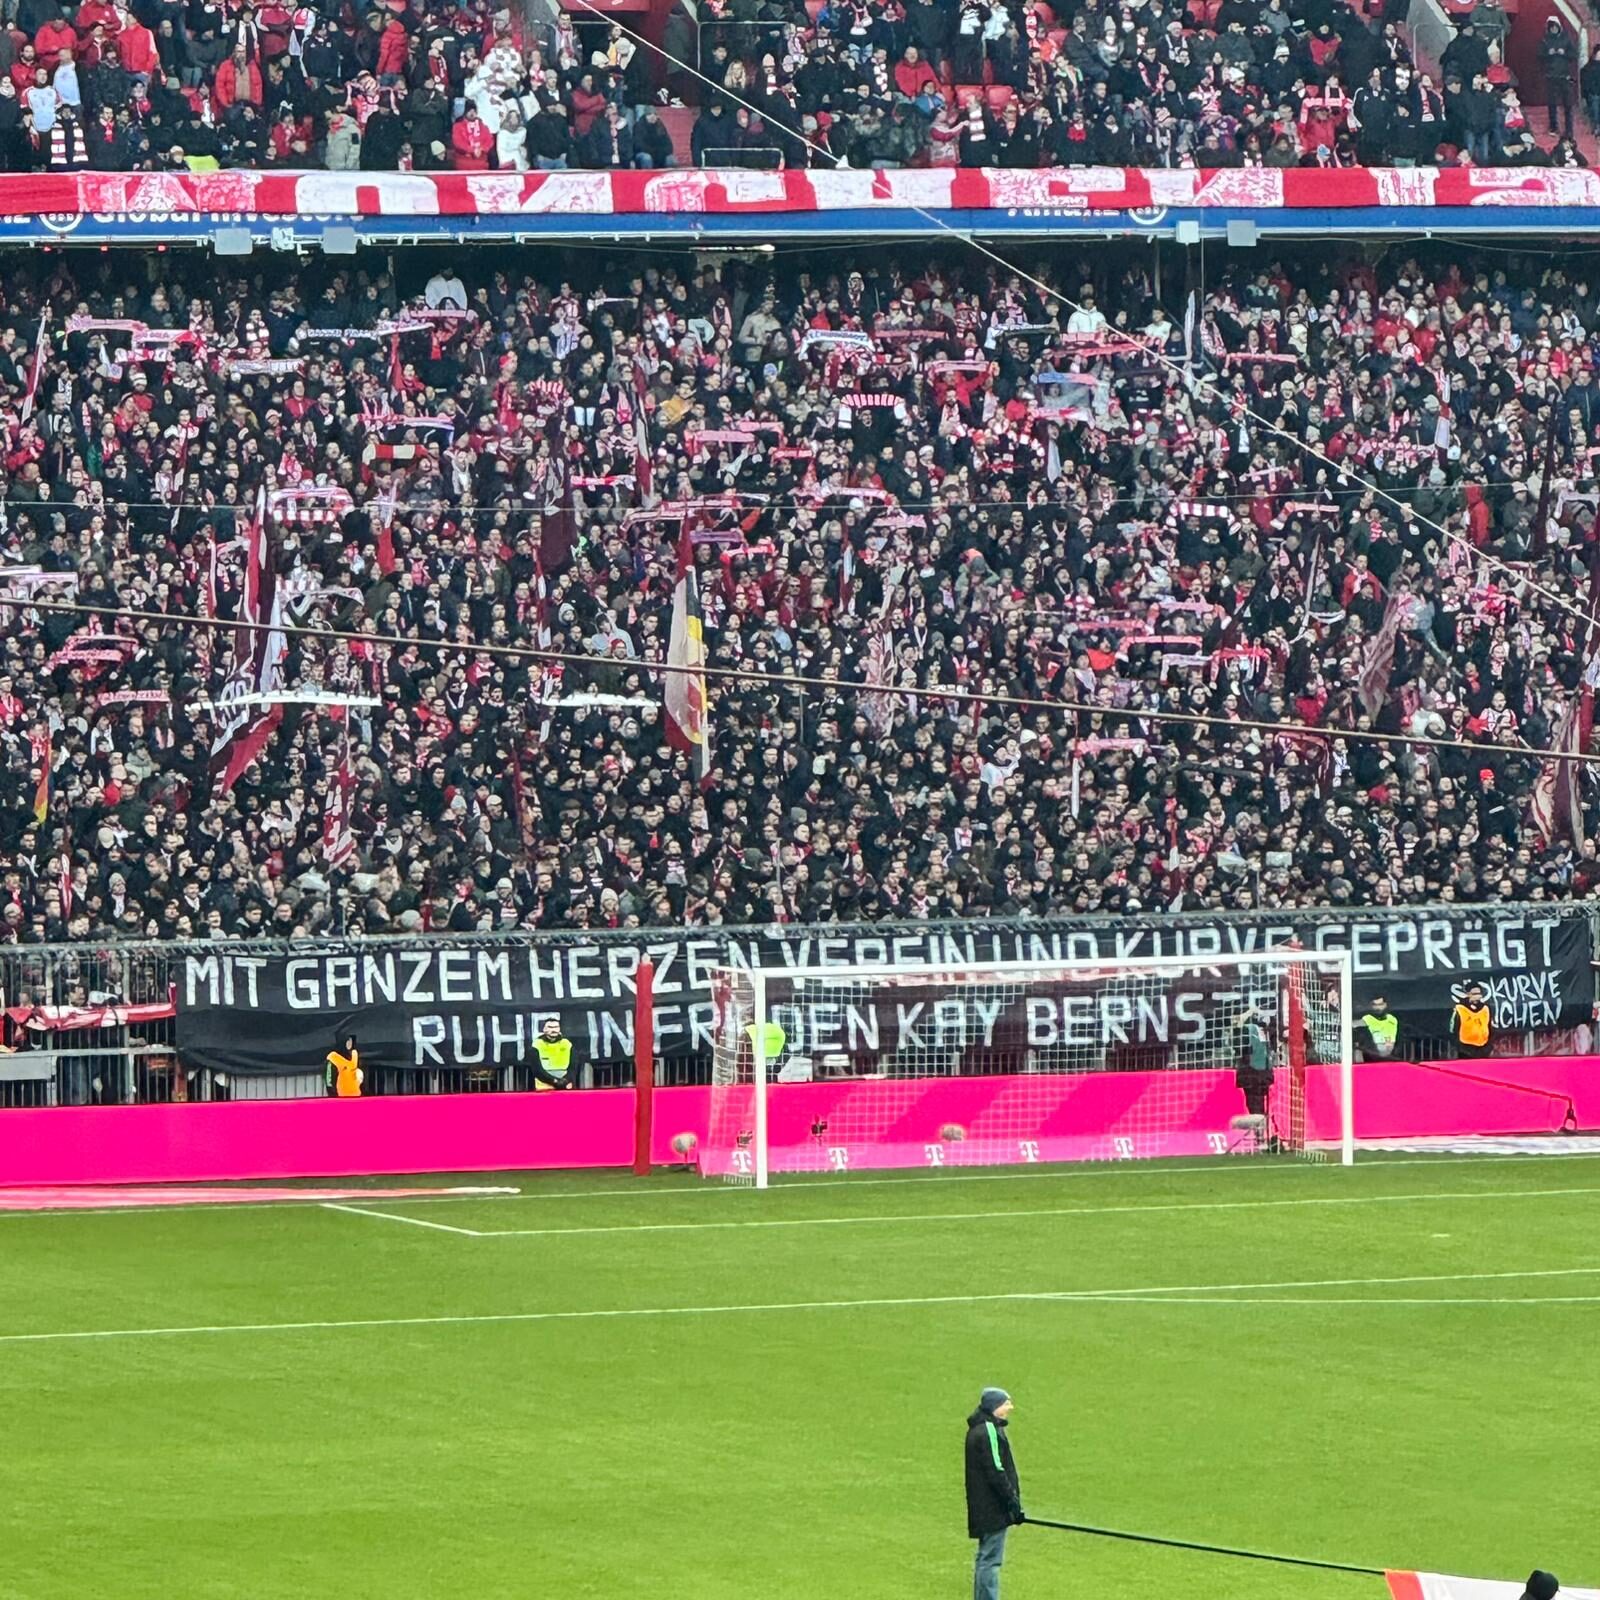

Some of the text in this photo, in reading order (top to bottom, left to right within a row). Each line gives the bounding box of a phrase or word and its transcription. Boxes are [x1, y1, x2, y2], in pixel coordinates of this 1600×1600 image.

[185, 955, 267, 1007] MIT
[285, 951, 514, 1009] GANZEM
[529, 940, 760, 998] HERZEN
[1316, 919, 1561, 973] GEPRÄGT
[1450, 970, 1562, 1003] SDKURVE
[588, 1011, 635, 1058] IN
[652, 1003, 879, 1053] FRDEN
[897, 1000, 1000, 1049] KAY
